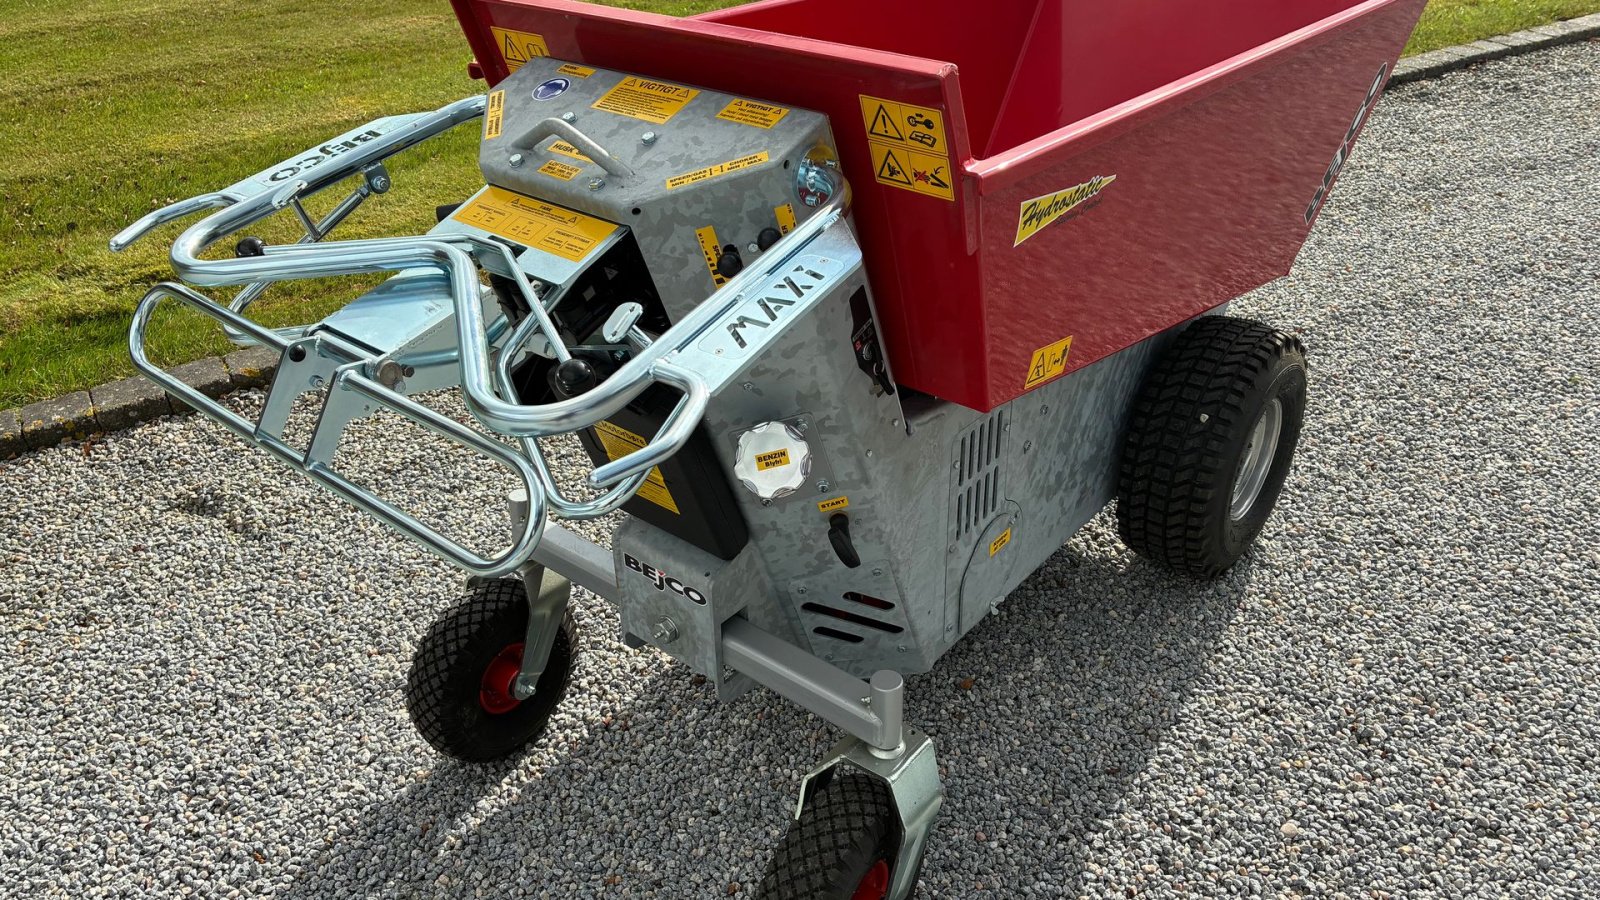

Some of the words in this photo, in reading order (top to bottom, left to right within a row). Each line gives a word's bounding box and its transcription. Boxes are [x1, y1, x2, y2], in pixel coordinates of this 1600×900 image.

[639, 81, 681, 94] VIGTIGT
[746, 102, 774, 112] VIGTIGT
[553, 143, 575, 154] HUSK
[729, 154, 758, 167] CHOKER
[691, 174, 708, 182] MAX
[1022, 177, 1103, 230] Hydrostatic
[757, 451, 787, 463] BENZIN
[820, 499, 846, 510] START
